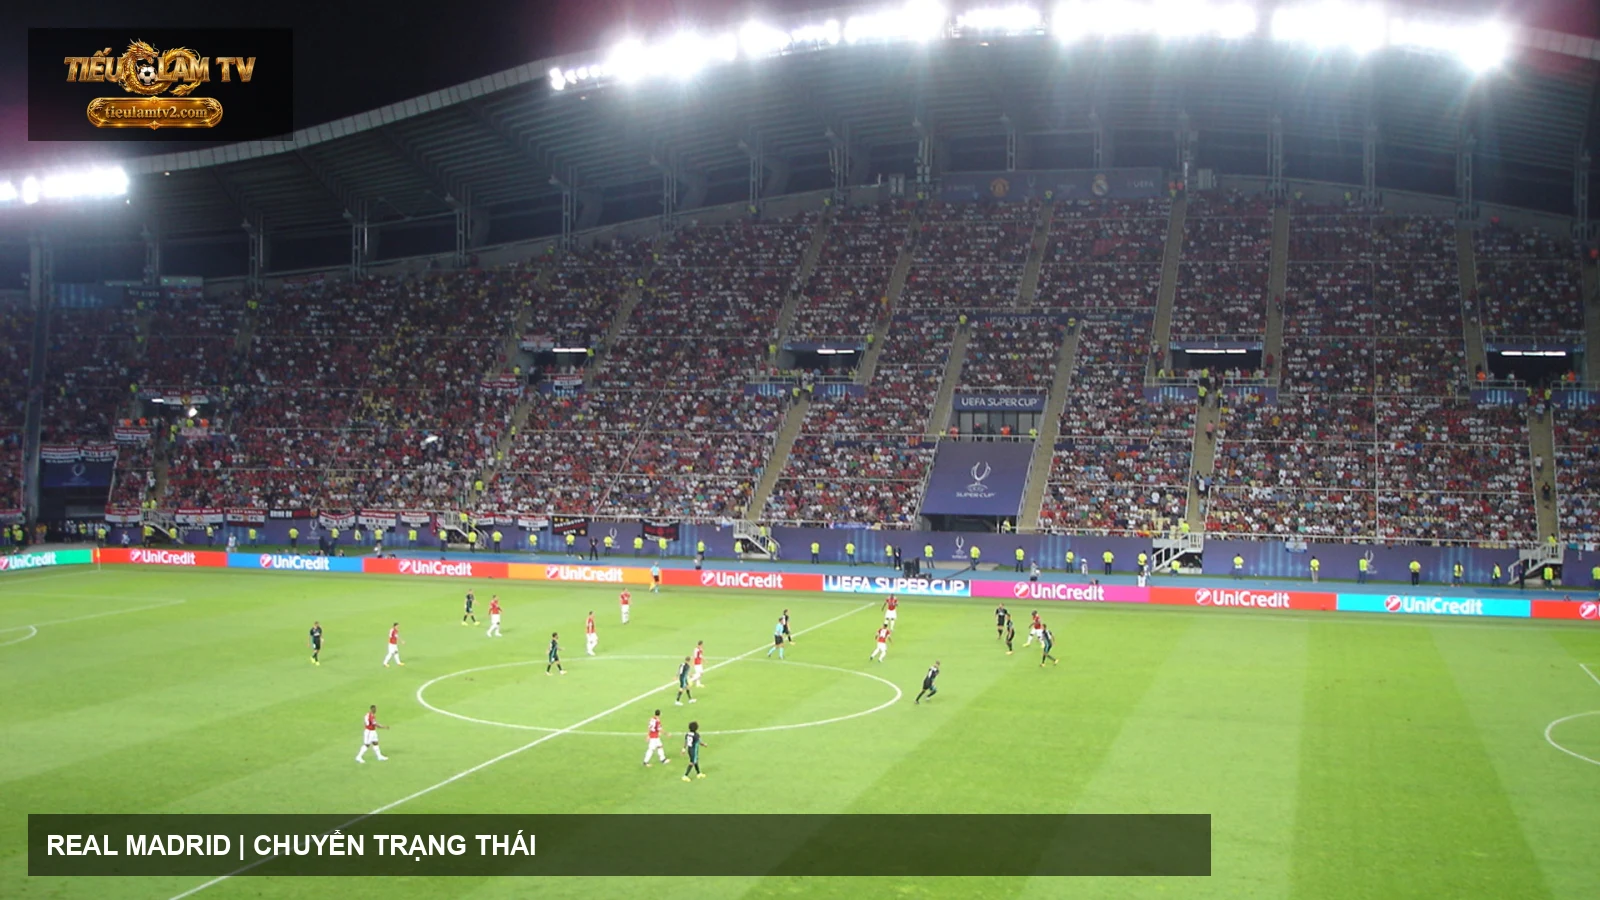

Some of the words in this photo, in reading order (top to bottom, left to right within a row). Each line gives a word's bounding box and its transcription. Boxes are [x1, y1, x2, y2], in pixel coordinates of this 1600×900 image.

[961, 397, 986, 406] UEFA
[987, 397, 1018, 407] SUPER
[1018, 397, 1038, 407] CUP
[9, 551, 57, 569] UniCredit
[142, 550, 196, 565] UniCredit
[272, 554, 330, 571] UniCredit
[411, 560, 472, 577] UniCredit
[558, 565, 623, 583] UniCredit
[716, 571, 783, 589] UniCredit
[829, 575, 872, 591] UEFA
[875, 576, 930, 593] SUPER
[930, 579, 965, 593] CUP
[1031, 583, 1105, 602] UniCredit
[1213, 589, 1290, 609] UniCredit
[1402, 596, 1483, 616] UniCredit
